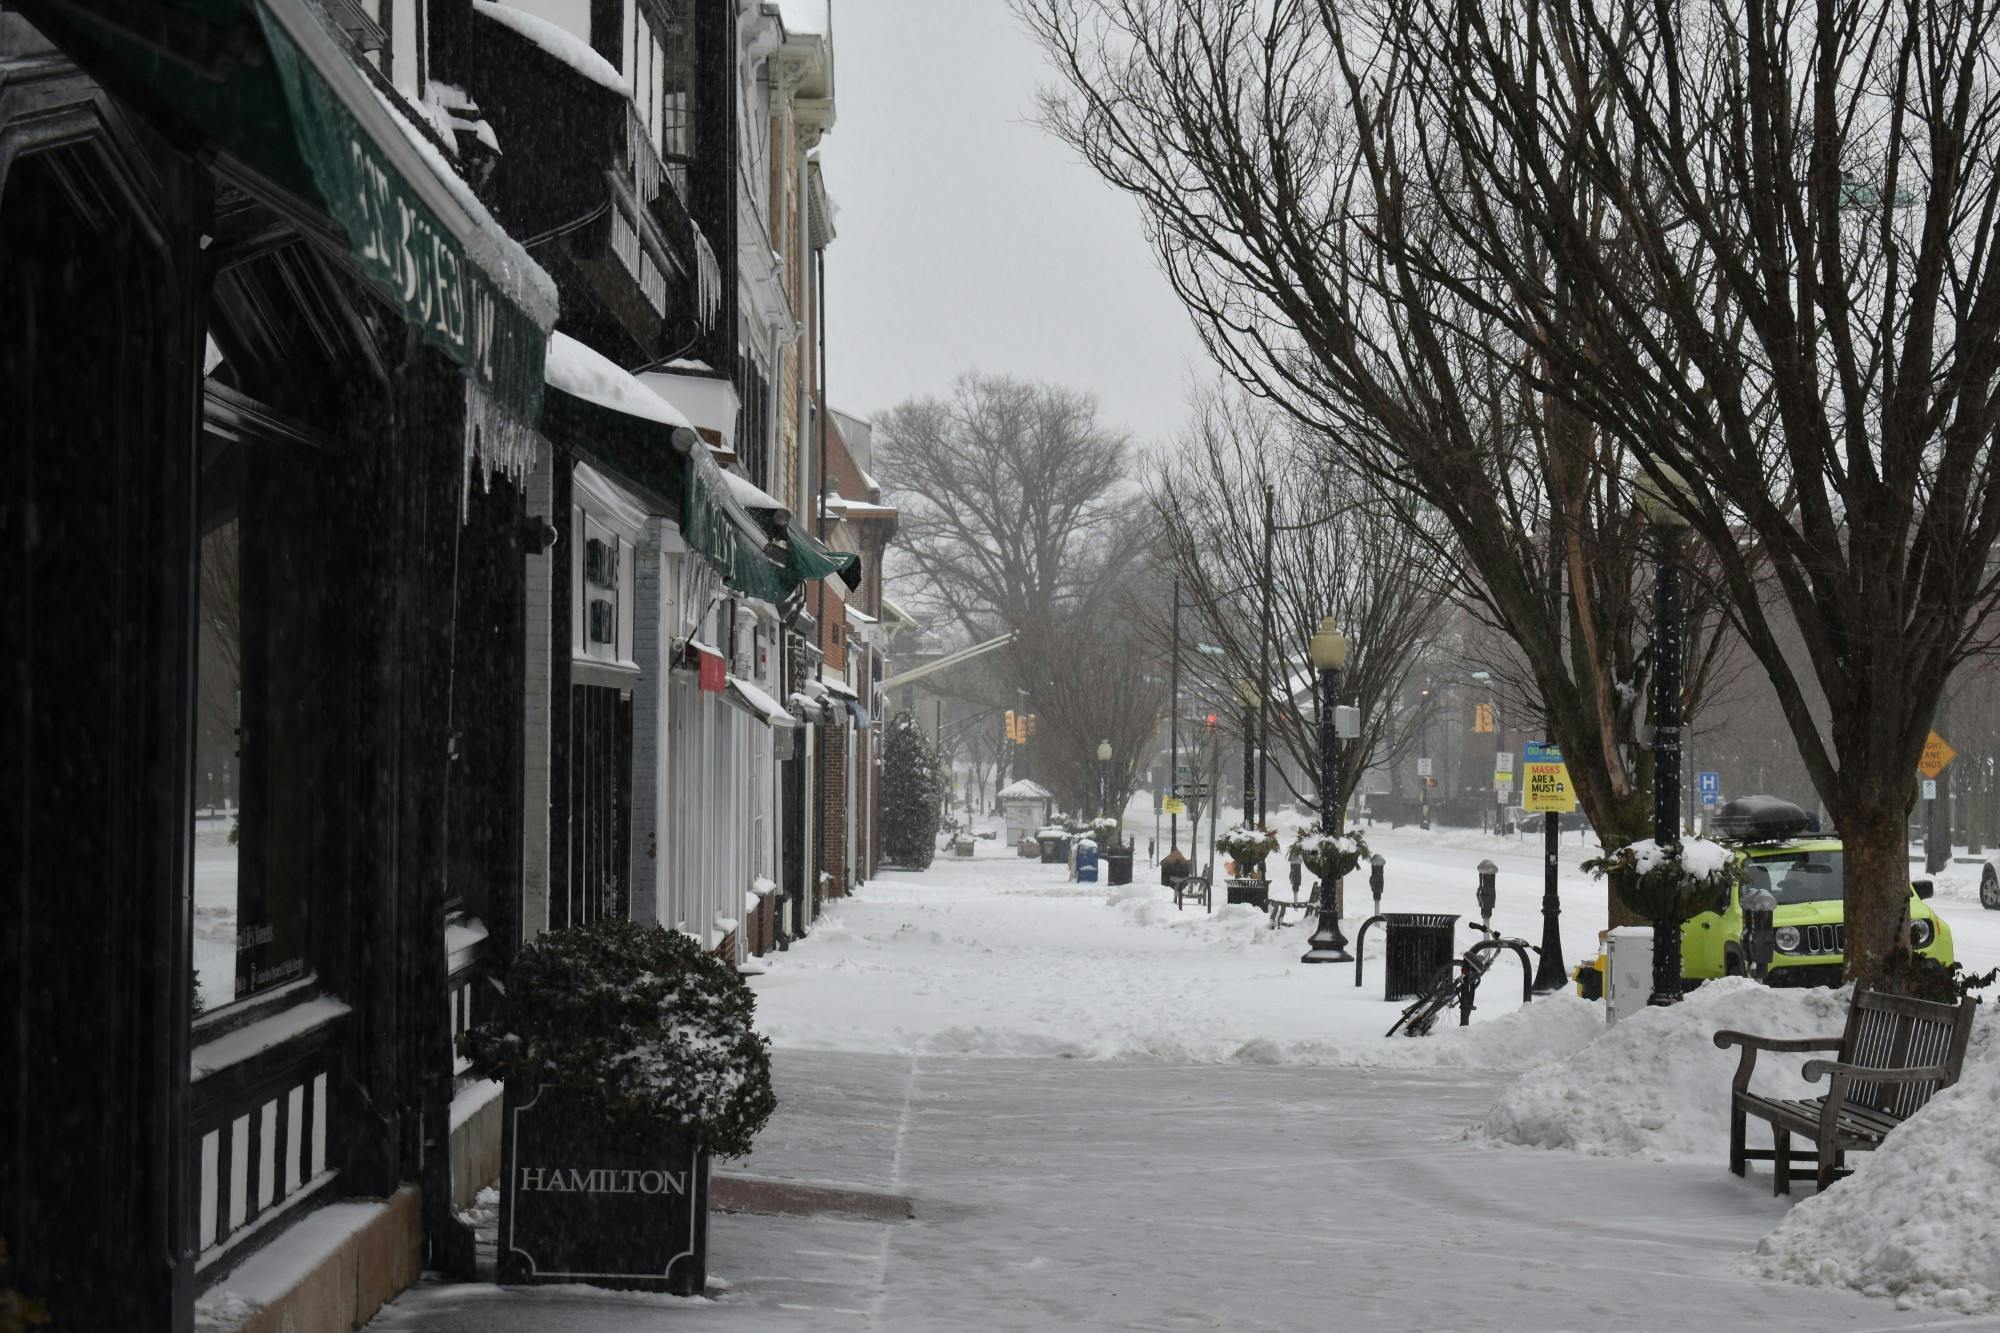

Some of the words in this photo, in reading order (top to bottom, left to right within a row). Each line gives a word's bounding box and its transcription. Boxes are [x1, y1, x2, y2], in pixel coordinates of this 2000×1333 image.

[1532, 765, 1560, 774] MASKS
[1532, 775, 1548, 783] ARE
[1550, 775, 1555, 783] A
[1703, 775, 1715, 790] H
[1532, 784, 1555, 792] MUST
[520, 1167, 688, 1196] HAMILTON
